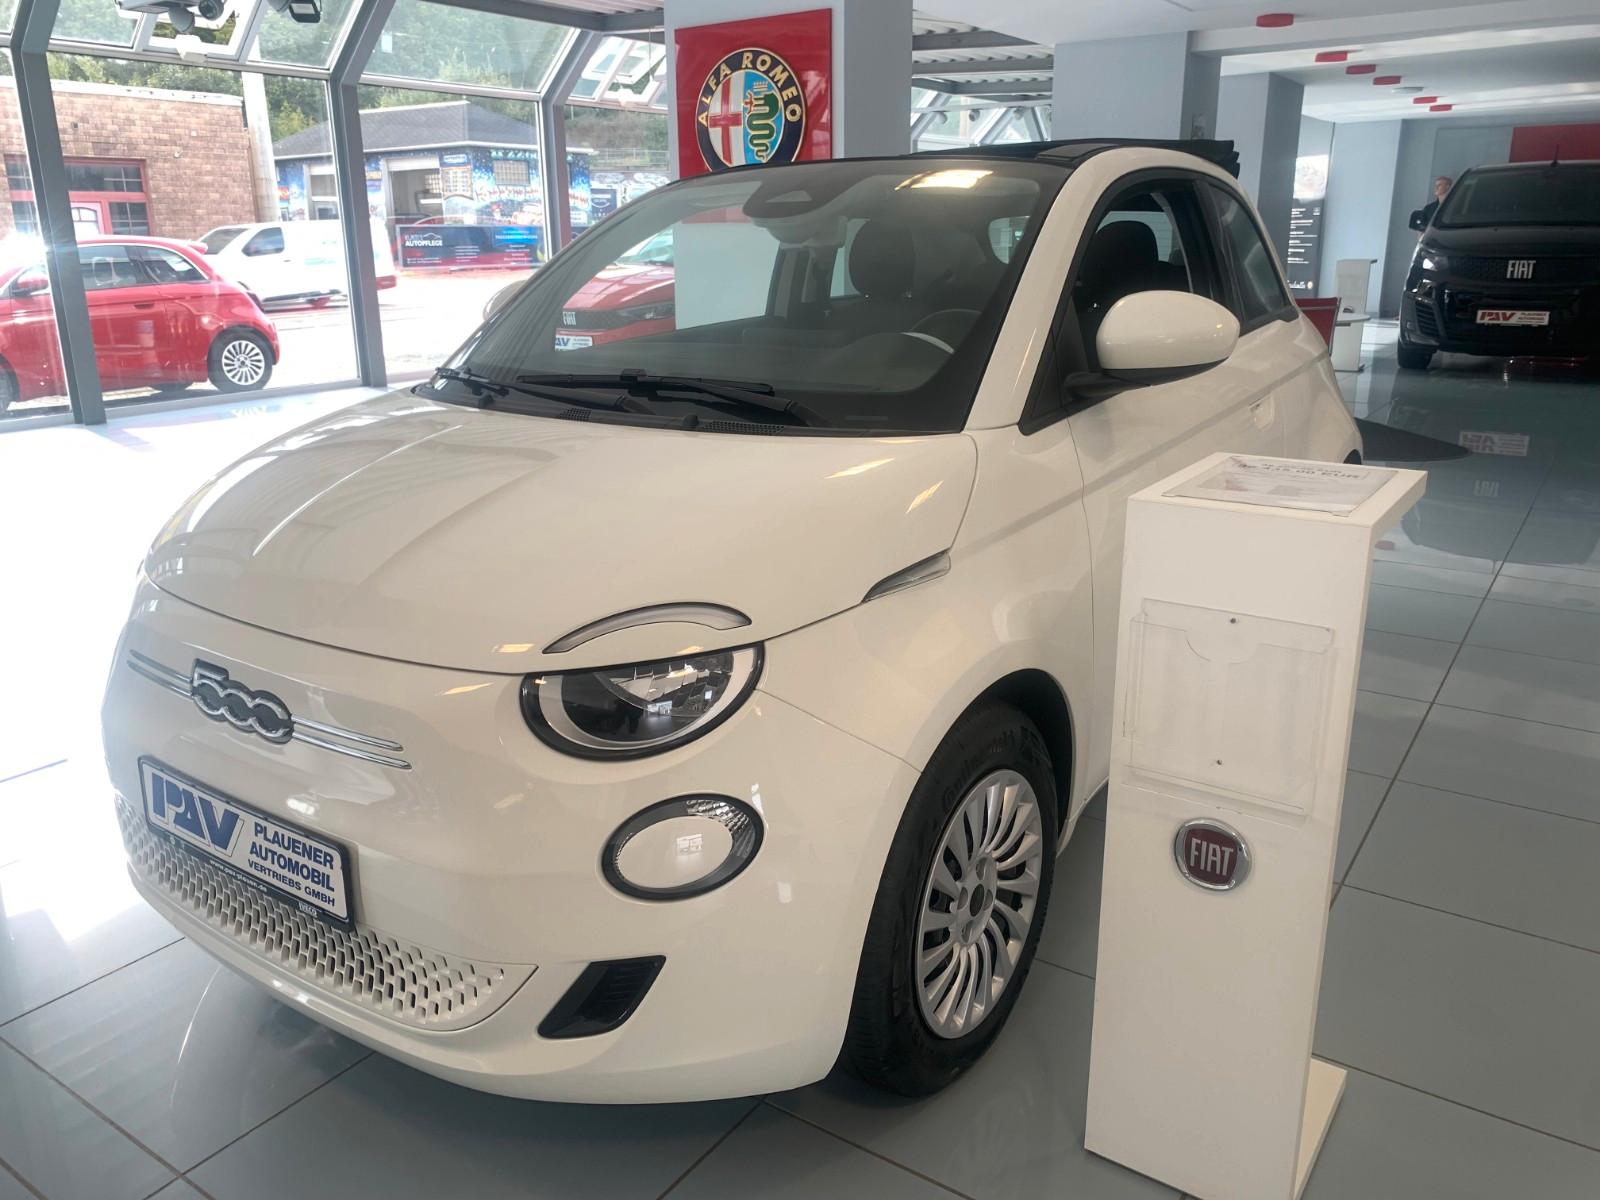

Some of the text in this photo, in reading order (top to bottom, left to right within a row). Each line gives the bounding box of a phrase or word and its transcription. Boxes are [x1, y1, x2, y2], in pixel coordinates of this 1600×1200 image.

[698, 52, 801, 128] ALFA ROMEO
[1506, 260, 1537, 279] FIAT
[1480, 311, 1516, 321] PAV
[191, 658, 294, 744] 500
[151, 772, 241, 852] PAV
[249, 840, 335, 893] AUTOMOBIL
[254, 821, 335, 870] PLAUENER
[1189, 837, 1234, 876] FIAT
[248, 859, 335, 907] VERTRIEBS GMBH
